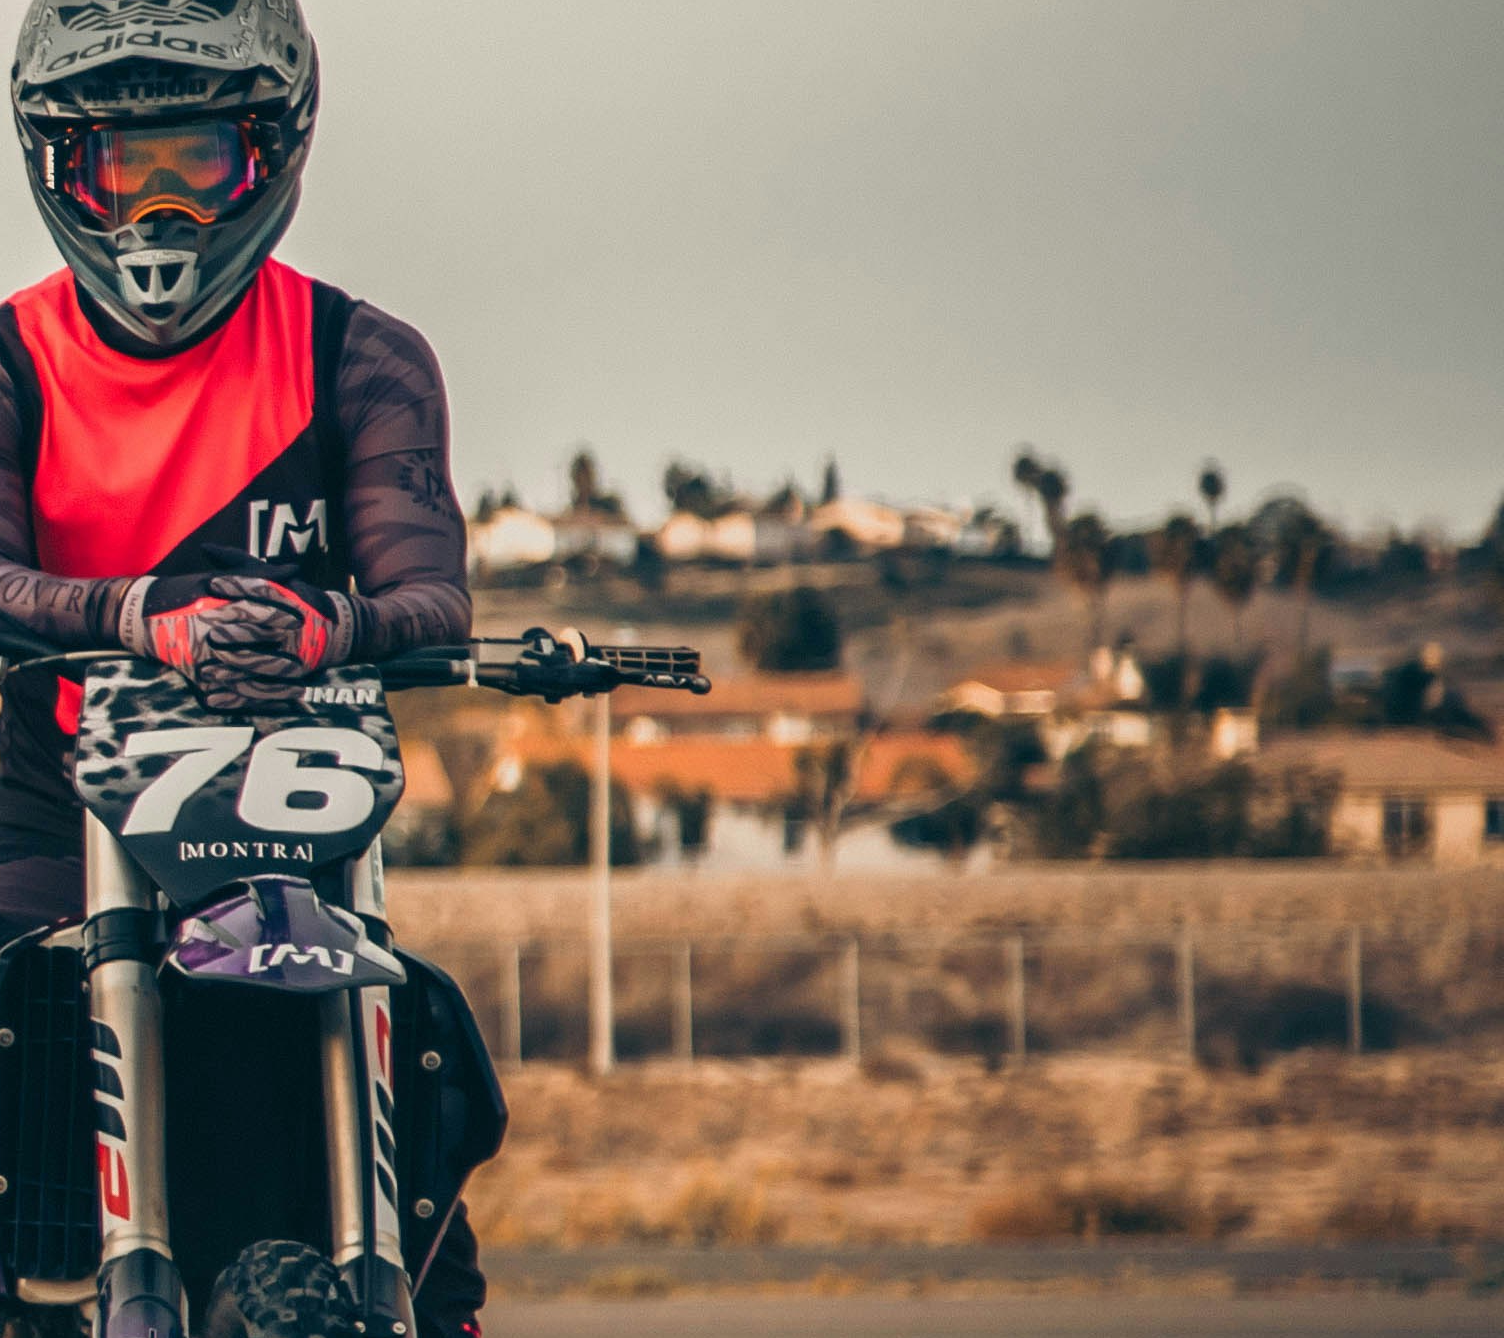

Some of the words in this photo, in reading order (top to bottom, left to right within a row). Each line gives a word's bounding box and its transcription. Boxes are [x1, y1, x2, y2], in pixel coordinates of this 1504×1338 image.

[47, 30, 229, 71] adidas
[82, 77, 208, 102] METHOD
[121, 726, 384, 836] 76
